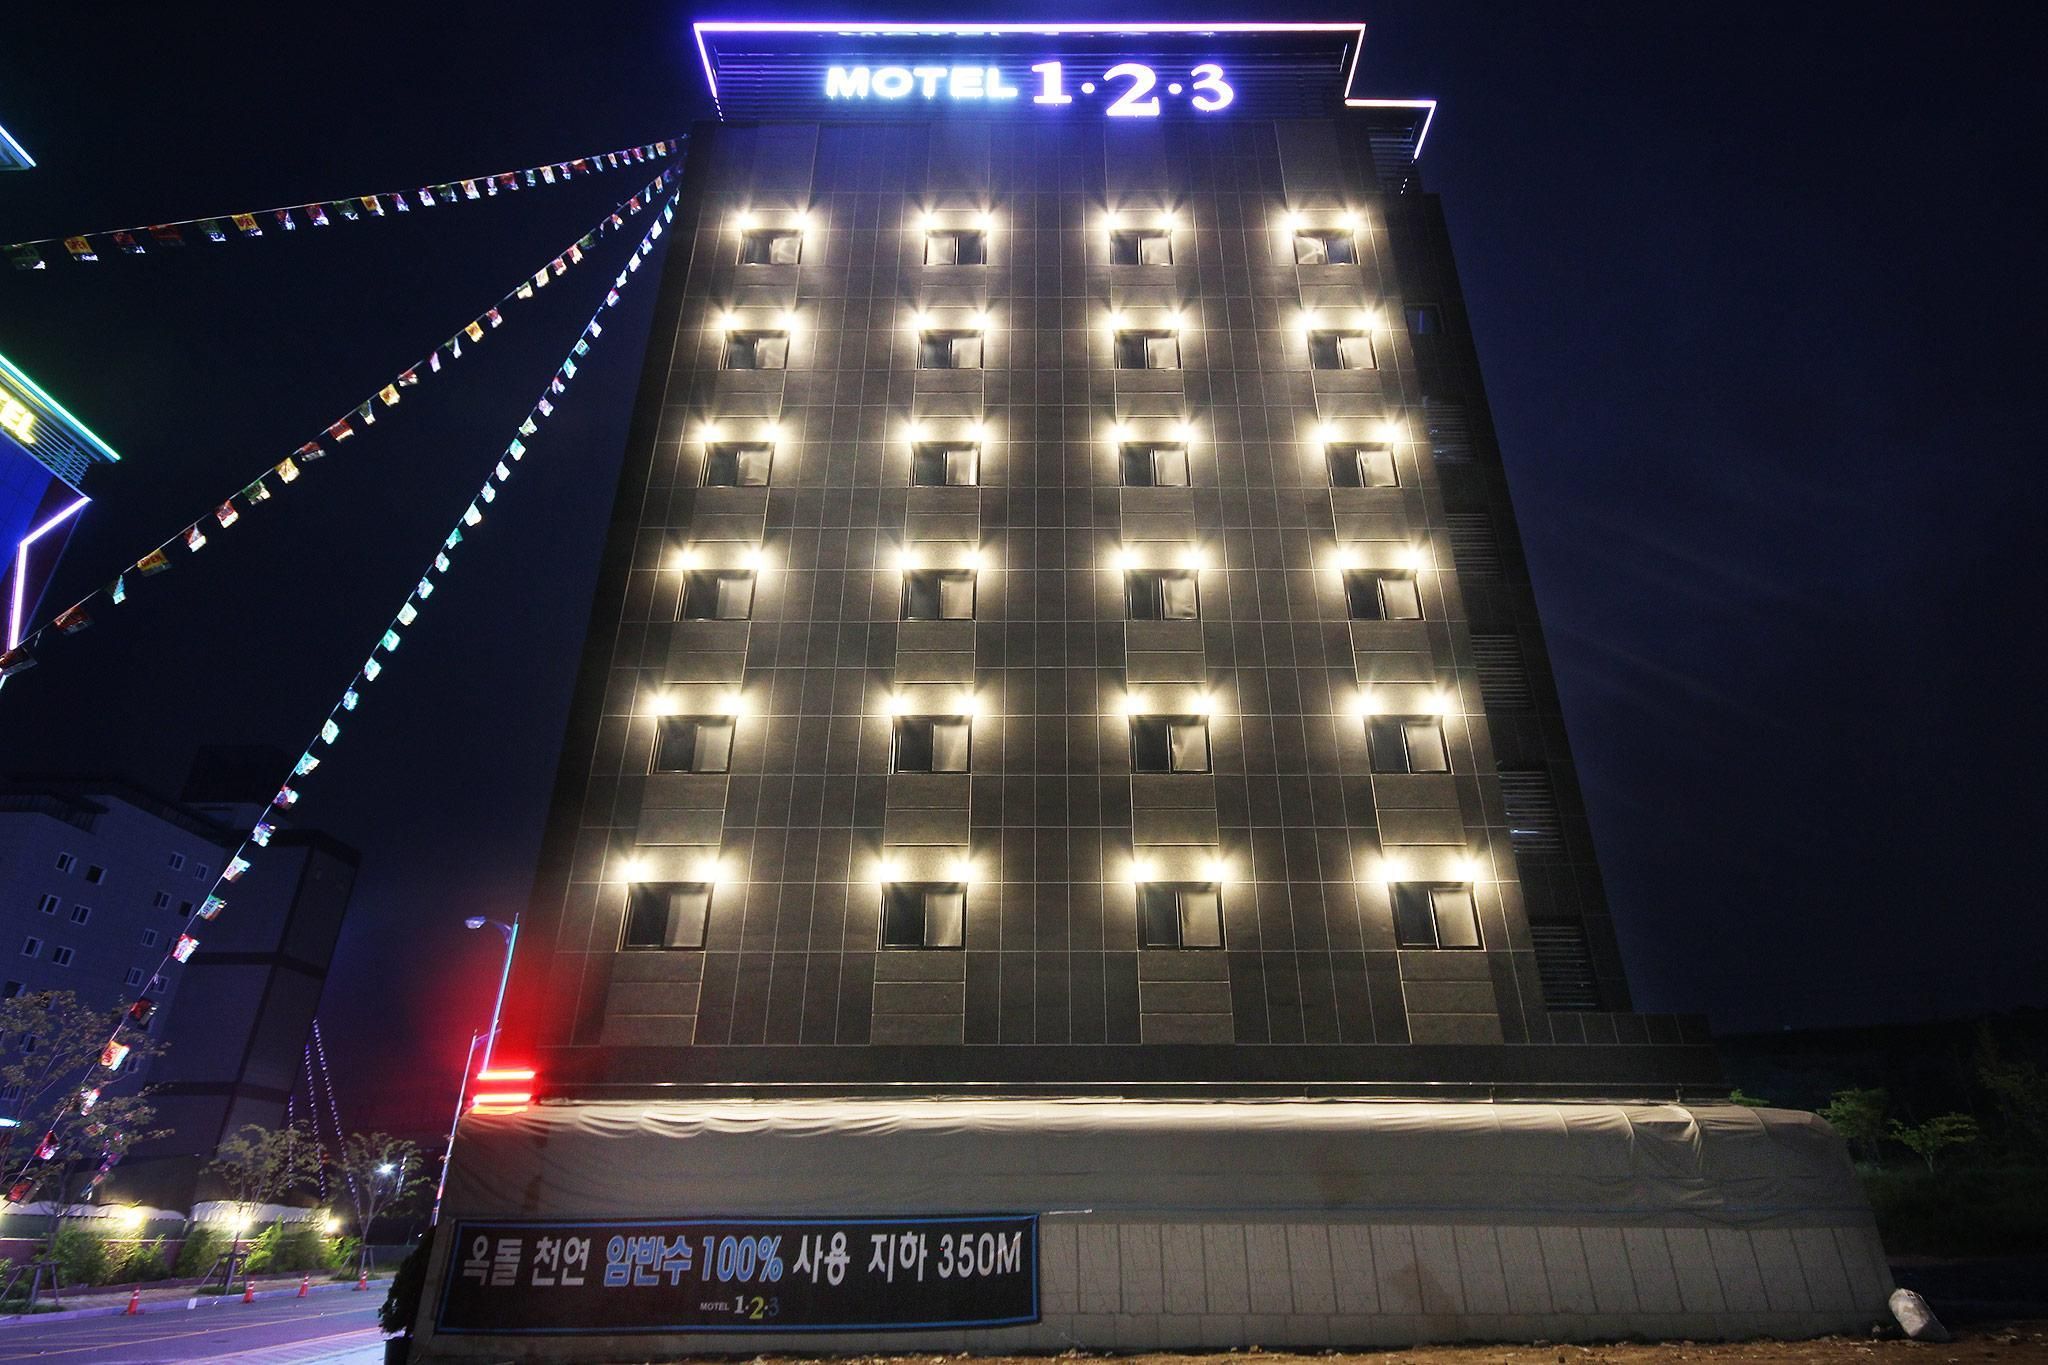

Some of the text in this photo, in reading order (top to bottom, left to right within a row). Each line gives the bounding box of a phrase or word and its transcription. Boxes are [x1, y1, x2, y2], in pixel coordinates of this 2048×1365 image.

[825, 67, 1019, 99] MOTEL
[531, 1236, 590, 1286] 천연
[603, 1235, 693, 1287] 암반수
[701, 1235, 783, 1283] 100%
[793, 1231, 850, 1286] 사용
[868, 1231, 928, 1283] 지하
[937, 1231, 1022, 1279] 350M
[700, 1302, 730, 1311] MOTEL
